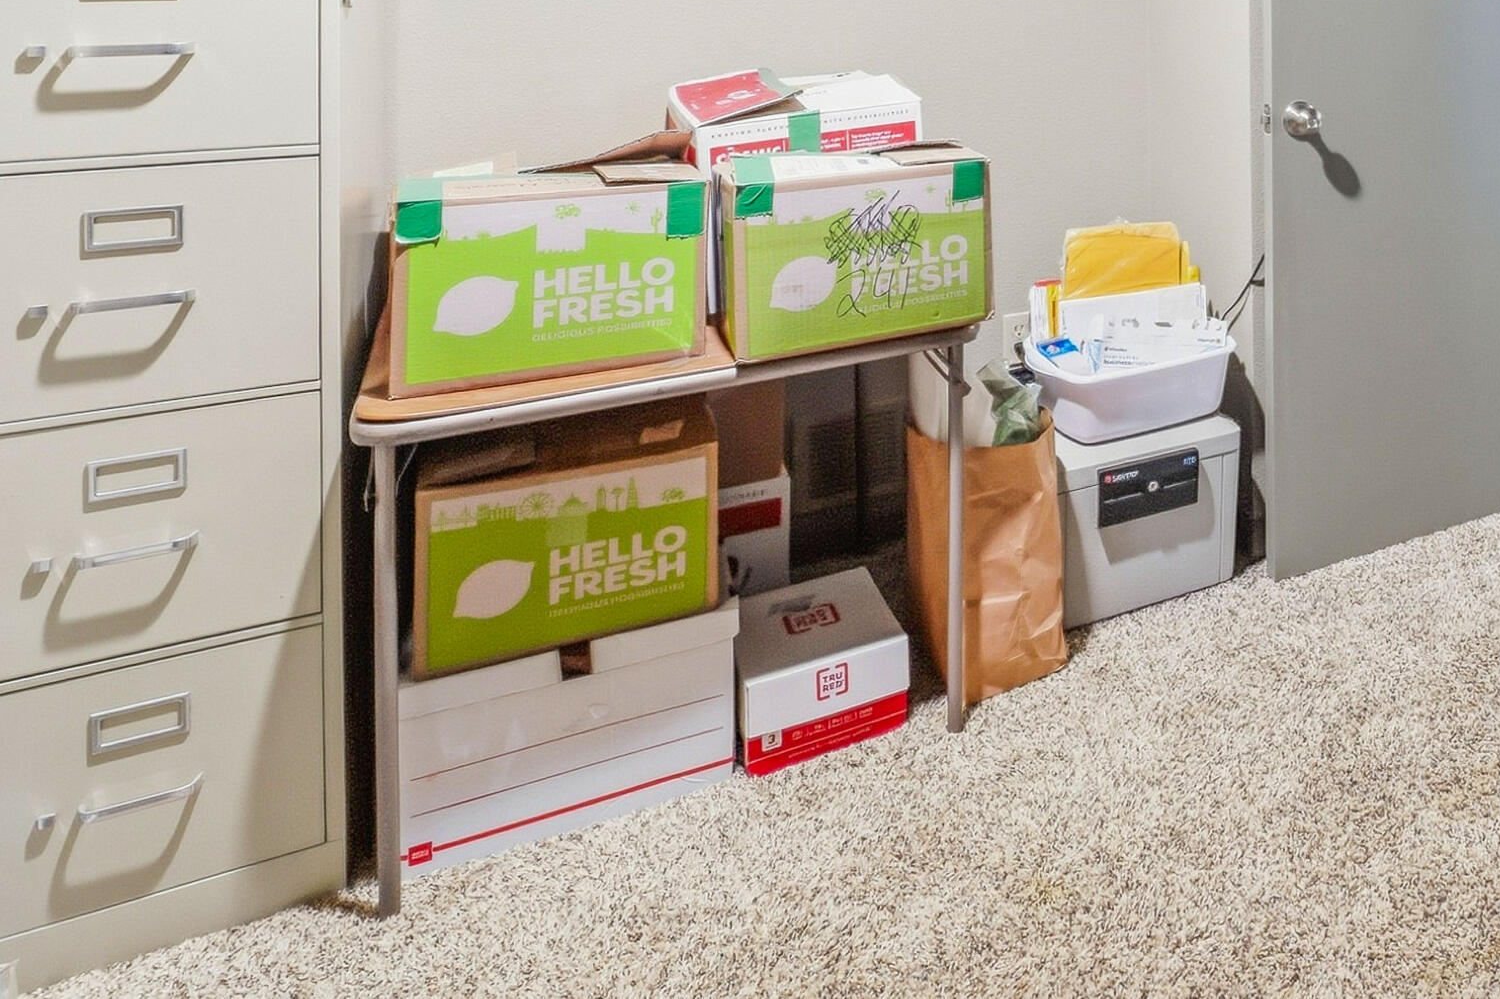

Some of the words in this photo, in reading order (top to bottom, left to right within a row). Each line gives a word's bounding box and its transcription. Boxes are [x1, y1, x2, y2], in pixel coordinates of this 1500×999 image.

[533, 257, 676, 299] HELLO
[836, 266, 911, 319] 241
[850, 260, 969, 303] FRESH
[532, 285, 675, 330] FRESH
[549, 525, 687, 577] HELLO
[548, 551, 687, 606] FRESH
[822, 672, 843, 683] TRU
[822, 680, 843, 692] RED
[767, 733, 776, 745] 3
